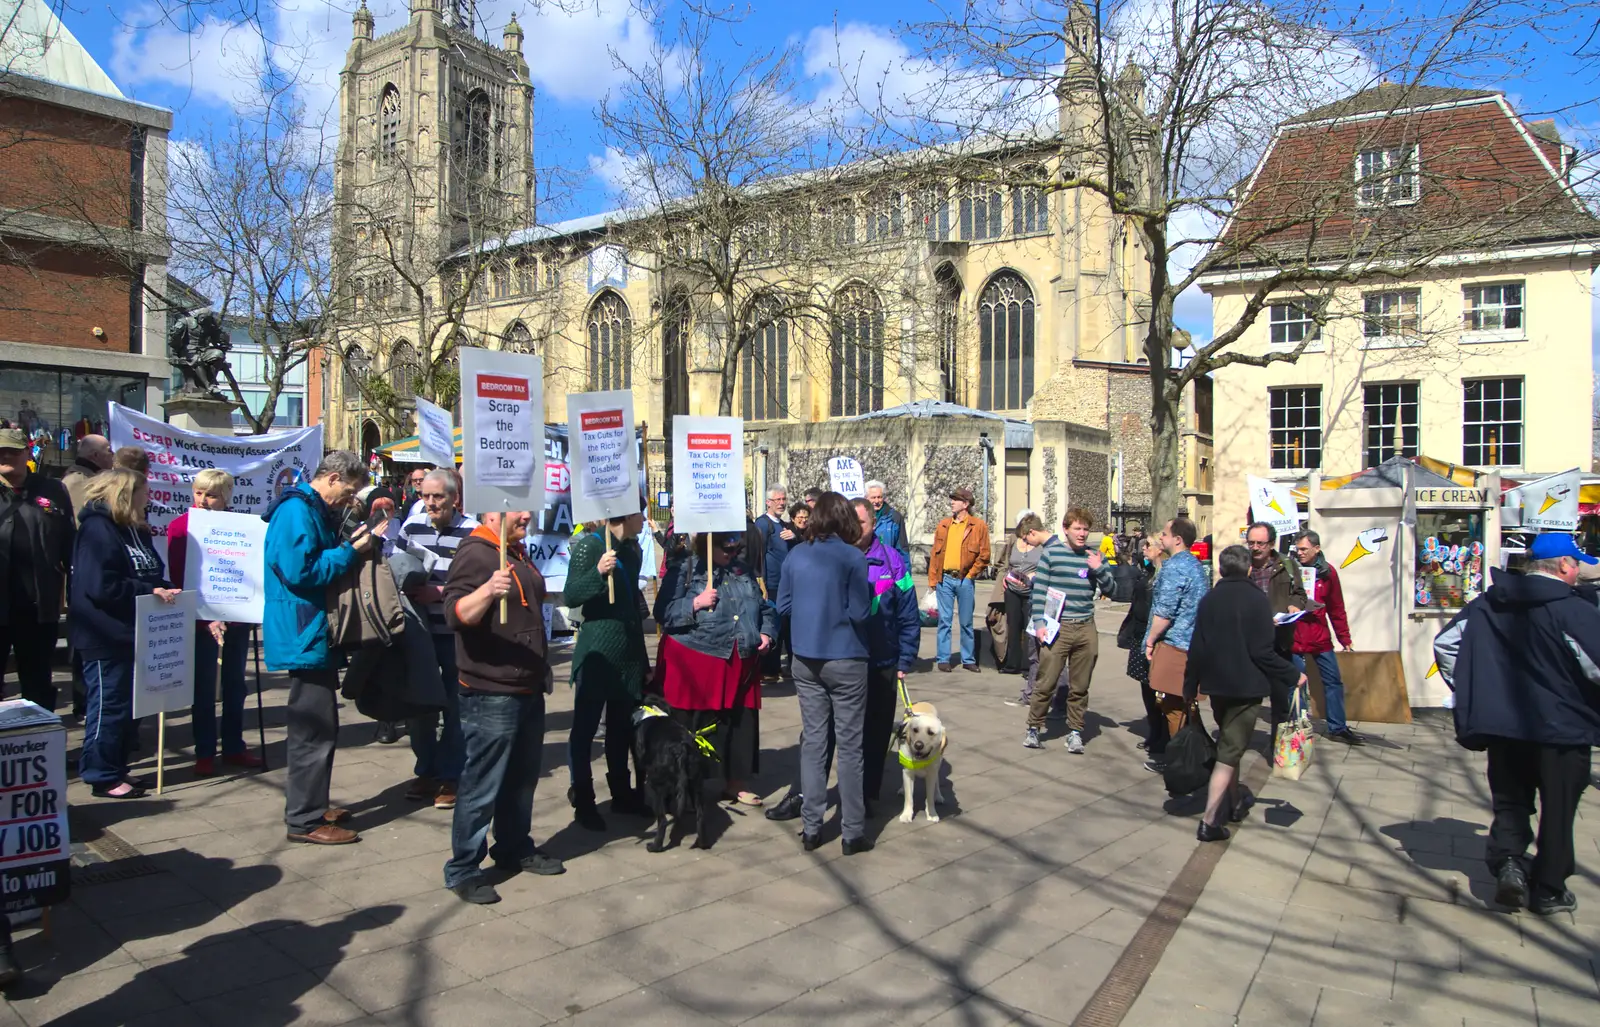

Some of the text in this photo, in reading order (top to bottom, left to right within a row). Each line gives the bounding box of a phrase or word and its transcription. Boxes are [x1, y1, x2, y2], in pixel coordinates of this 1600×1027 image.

[481, 382, 513, 392] BEDROOM
[488, 400, 520, 416] Scrap
[496, 420, 514, 431] the
[585, 416, 610, 425] BEDROOM
[133, 427, 172, 448] Scrap
[174, 438, 200, 451] Work
[201, 444, 244, 458] Capability
[480, 437, 529, 450] Bedroom
[588, 444, 598, 452] the
[600, 442, 616, 450] Rich
[147, 452, 215, 469] ack Atos
[496, 456, 515, 468] Tax
[588, 452, 622, 462] Misery for
[591, 464, 620, 474] Disabled
[837, 460, 854, 470] AXE
[267, 458, 285, 484] Norfolk
[692, 472, 716, 480] Misery
[146, 471, 178, 484] crap
[234, 476, 254, 486] Tax
[595, 476, 618, 484] People
[695, 482, 726, 490] Disabled
[840, 481, 857, 492] TAX
[148, 488, 190, 504] top the
[232, 494, 242, 504] of
[246, 494, 260, 504] the
[698, 492, 722, 500] People
[1416, 489, 1488, 502] ICE CREAM
[211, 528, 232, 537] Scrap
[204, 538, 238, 546] Bedroom
[218, 558, 236, 566] Stop
[208, 566, 244, 576] Attacking
[210, 576, 242, 584] Disabled
[212, 584, 238, 592] People
[148, 612, 184, 622] Government
[158, 624, 168, 632] the
[170, 622, 183, 630] Rich
[148, 636, 183, 648] By the Rich
[153, 650, 179, 660] Austerity
[148, 660, 184, 672] for Everyone
[160, 672, 172, 680] Else
[0, 740, 48, 756] Worker
[1, 754, 48, 788] UTS
[11, 788, 58, 818] FOR
[16, 822, 62, 854] JOB
[2, 866, 56, 894] to win
